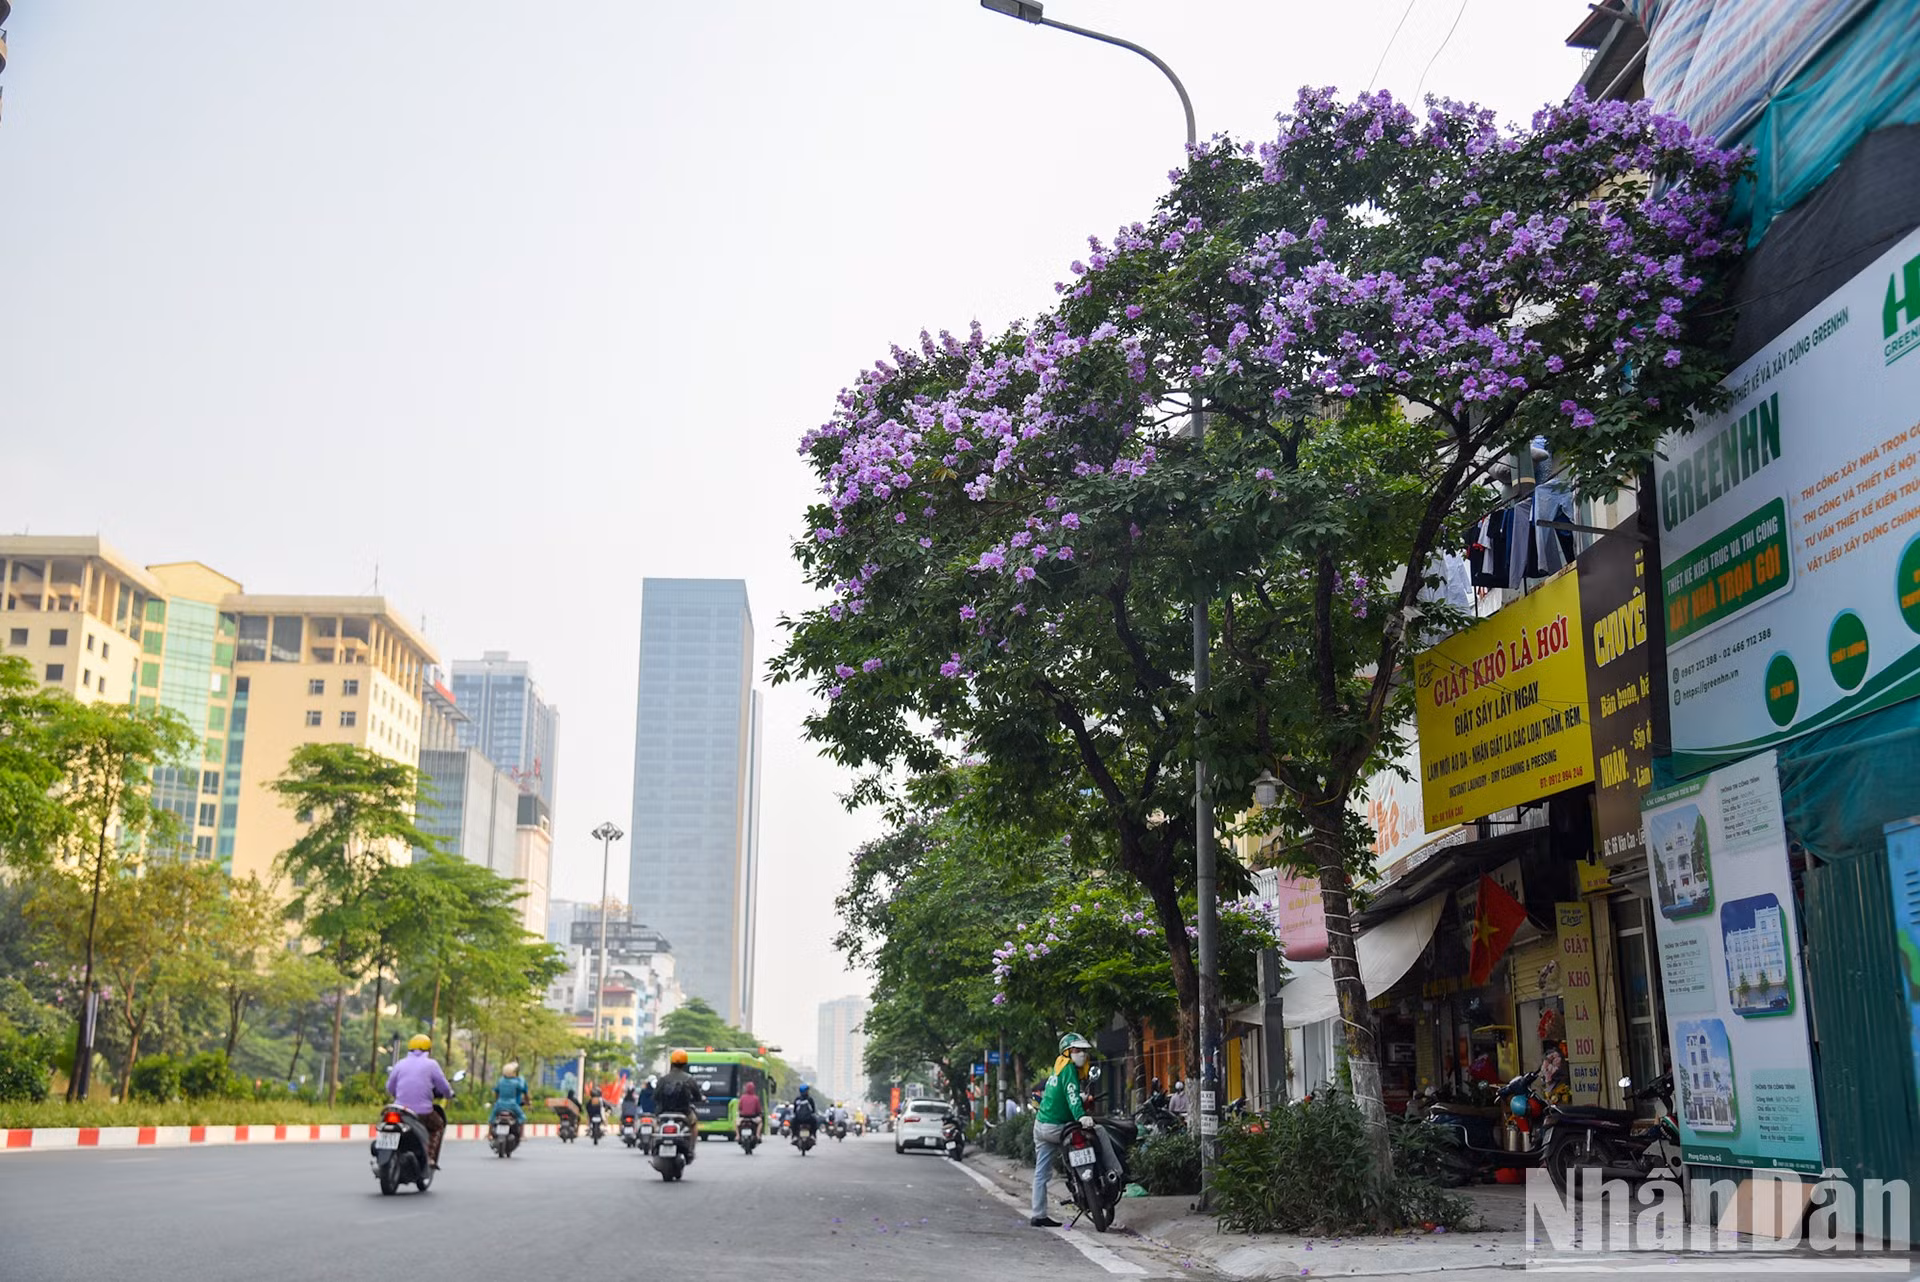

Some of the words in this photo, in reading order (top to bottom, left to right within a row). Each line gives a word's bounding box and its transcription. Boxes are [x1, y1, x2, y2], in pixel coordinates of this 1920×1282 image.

[1761, 361, 1771, 385] VÀ
[1772, 352, 1787, 377] XÂY
[1789, 336, 1810, 366] DỰNG
[1811, 306, 1849, 347] GREENHN
[1661, 391, 1781, 533] GREENHN
[1801, 486, 1815, 501] THI
[1816, 471, 1839, 493] CÔNG
[1841, 460, 1858, 479] XÂY
[1859, 446, 1880, 467] NHÀ
[1881, 431, 1908, 455] TRỌN
[1803, 509, 1816, 525] THI
[1818, 495, 1841, 517] CÔNG
[1843, 486, 1855, 502] VÀ
[1856, 470, 1882, 495] THIẾT
[1884, 460, 1896, 480] KẾ
[1898, 453, 1917, 472] NỘI
[1741, 529, 1755, 552] THI
[1756, 516, 1778, 543] CÔNG
[1804, 534, 1816, 549] TƯ
[1817, 522, 1834, 542] VẤN
[1836, 507, 1860, 532] THIẾT
[1862, 498, 1874, 519] KẾ
[1875, 487, 1897, 511] KIẾN
[1806, 557, 1823, 572] VẬT
[1824, 545, 1843, 565] LIỆU
[1844, 533, 1861, 554] XÂY
[1862, 522, 1889, 544] DỰNG
[1593, 585, 1647, 668] CHUYÊ
[1433, 664, 1468, 708] GIẶT
[1472, 640, 1507, 691] KHÔ
[1510, 628, 1533, 673] LÀ
[1536, 614, 1569, 660] HƠI
[1454, 707, 1473, 737] GIẶT
[1476, 696, 1493, 729] SẤY
[1514, 681, 1539, 711] NGAY
[1600, 694, 1617, 719] Bán
[1460, 750, 1468, 769] DA
[1472, 739, 1489, 765] NHẬN
[1513, 725, 1526, 750] CÁC
[1527, 721, 1542, 745] LOẠI
[1564, 704, 1581, 729] RÈM
[1449, 781, 1467, 798] INSTANT
[1501, 761, 1525, 780] CLEANING
[1531, 750, 1557, 770] PRESSING
[1564, 934, 1589, 959] GIẶT
[1568, 966, 1590, 987] KHÔ
[1575, 1000, 1589, 1021] LÀ
[1575, 1035, 1595, 1055] HƠI
